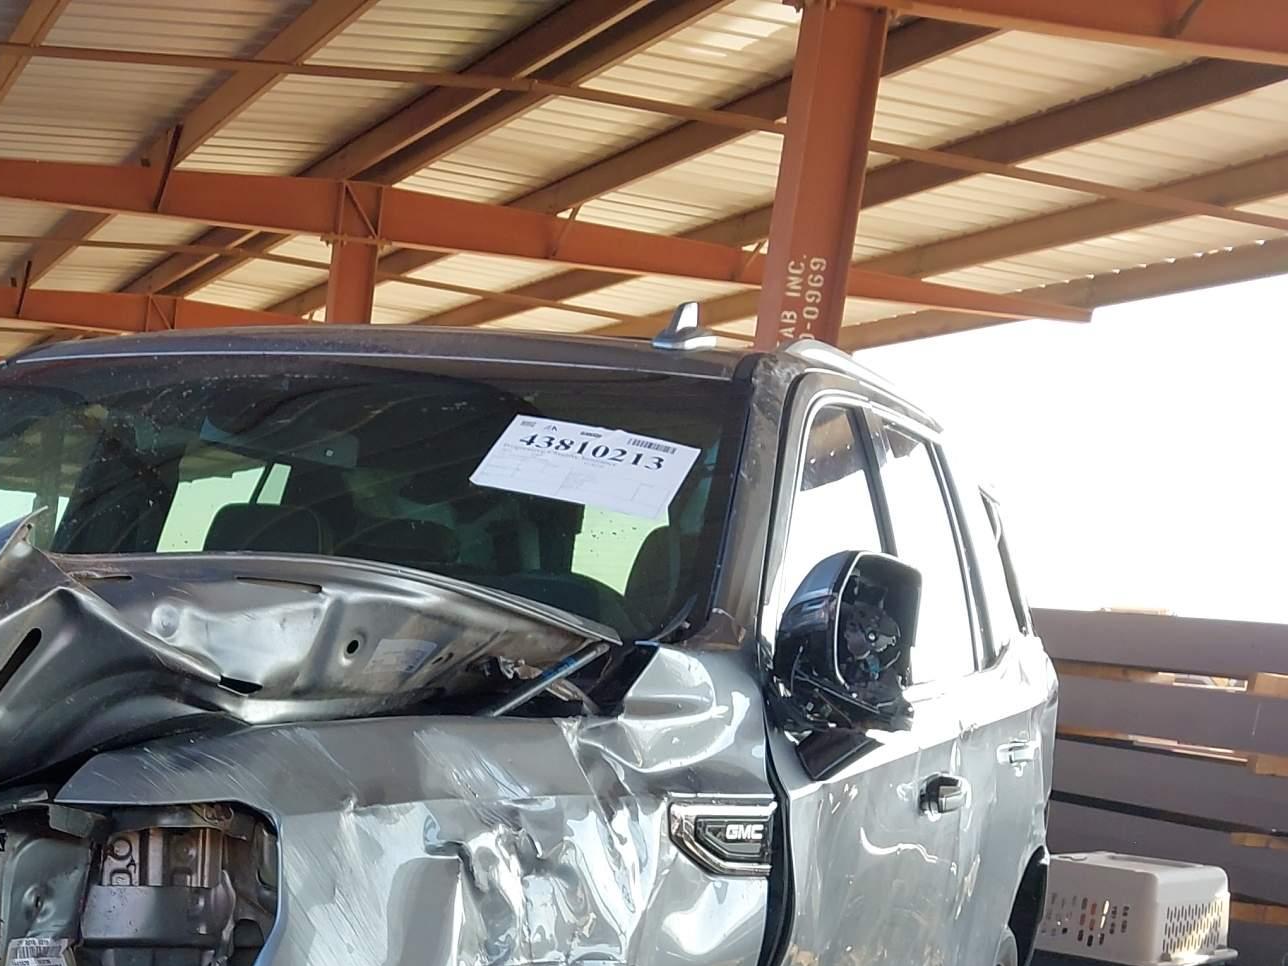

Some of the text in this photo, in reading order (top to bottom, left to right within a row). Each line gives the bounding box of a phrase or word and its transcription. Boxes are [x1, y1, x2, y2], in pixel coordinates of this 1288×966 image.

[777, 254, 807, 346] AB INC.
[519, 433, 665, 471] 43810213
[725, 823, 764, 840] GMC
